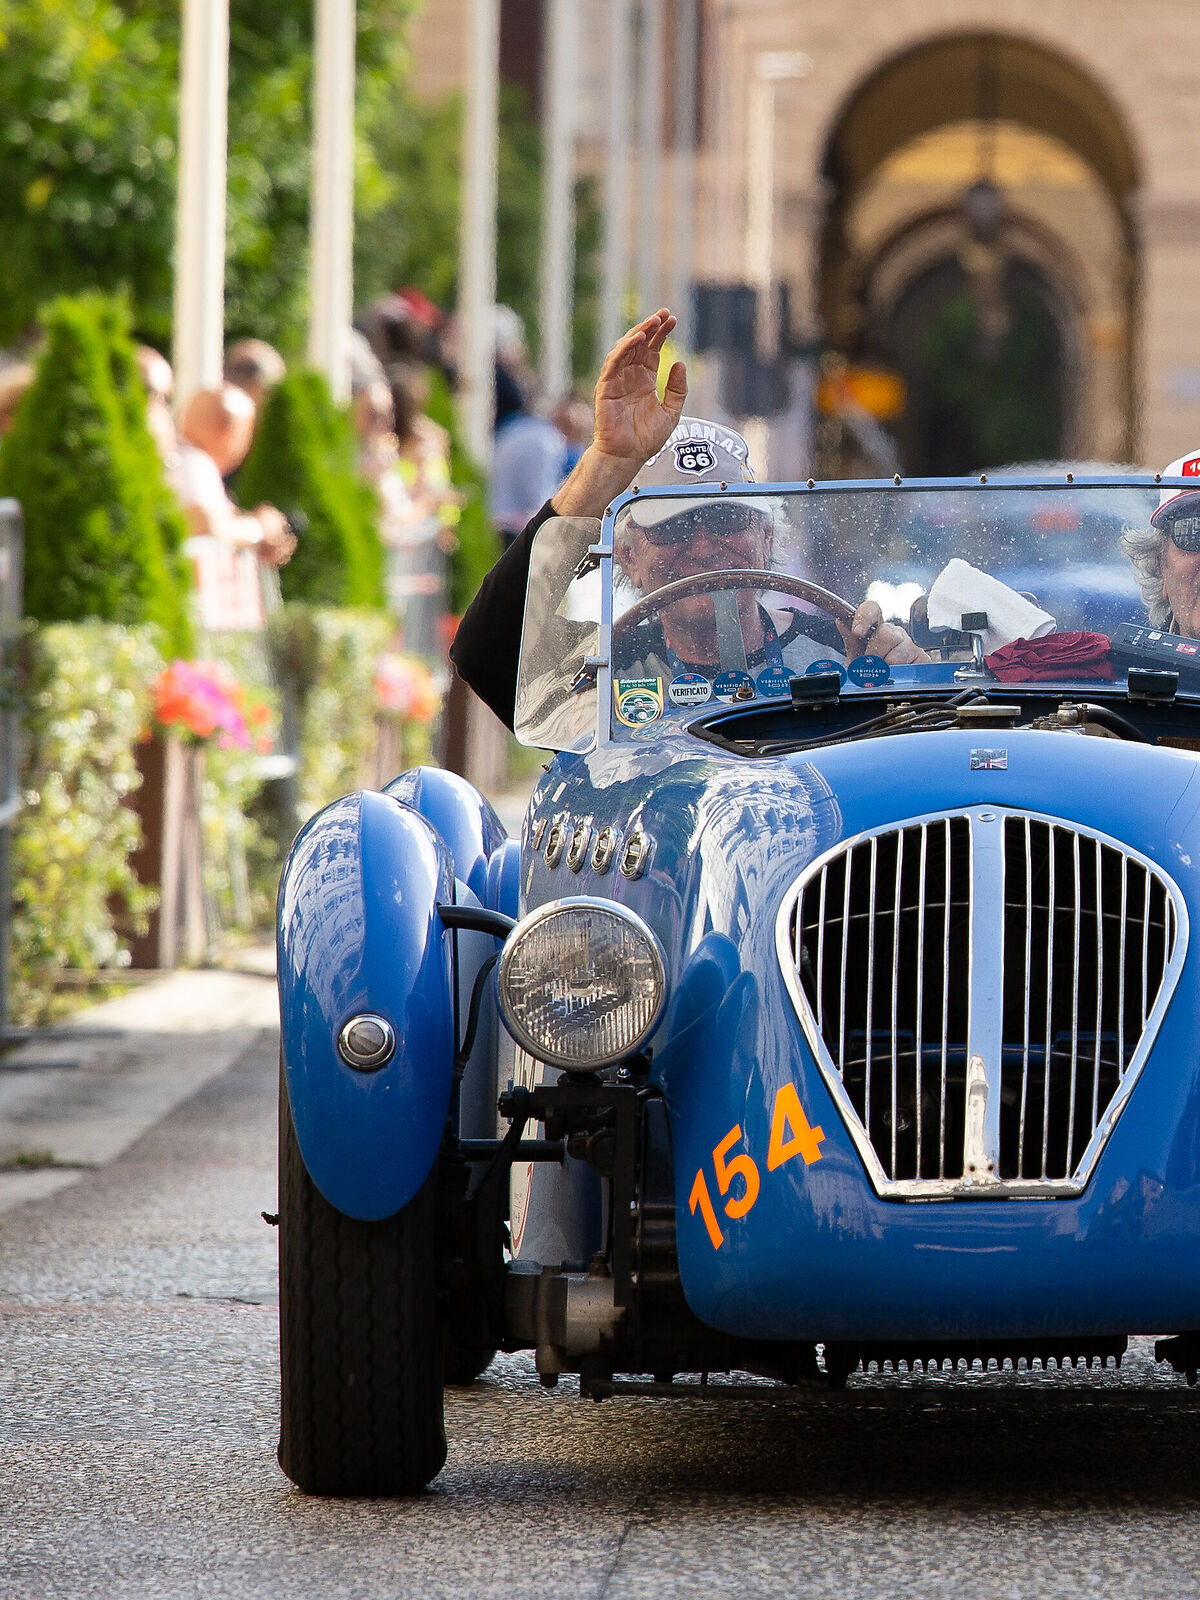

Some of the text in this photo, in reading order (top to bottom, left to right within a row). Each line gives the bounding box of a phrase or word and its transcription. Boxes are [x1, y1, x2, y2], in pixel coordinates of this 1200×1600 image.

[680, 446, 707, 454] ROUTE
[682, 453, 710, 468] 66
[672, 688, 708, 697] VERIFICATO
[688, 1081, 826, 1251] 154
